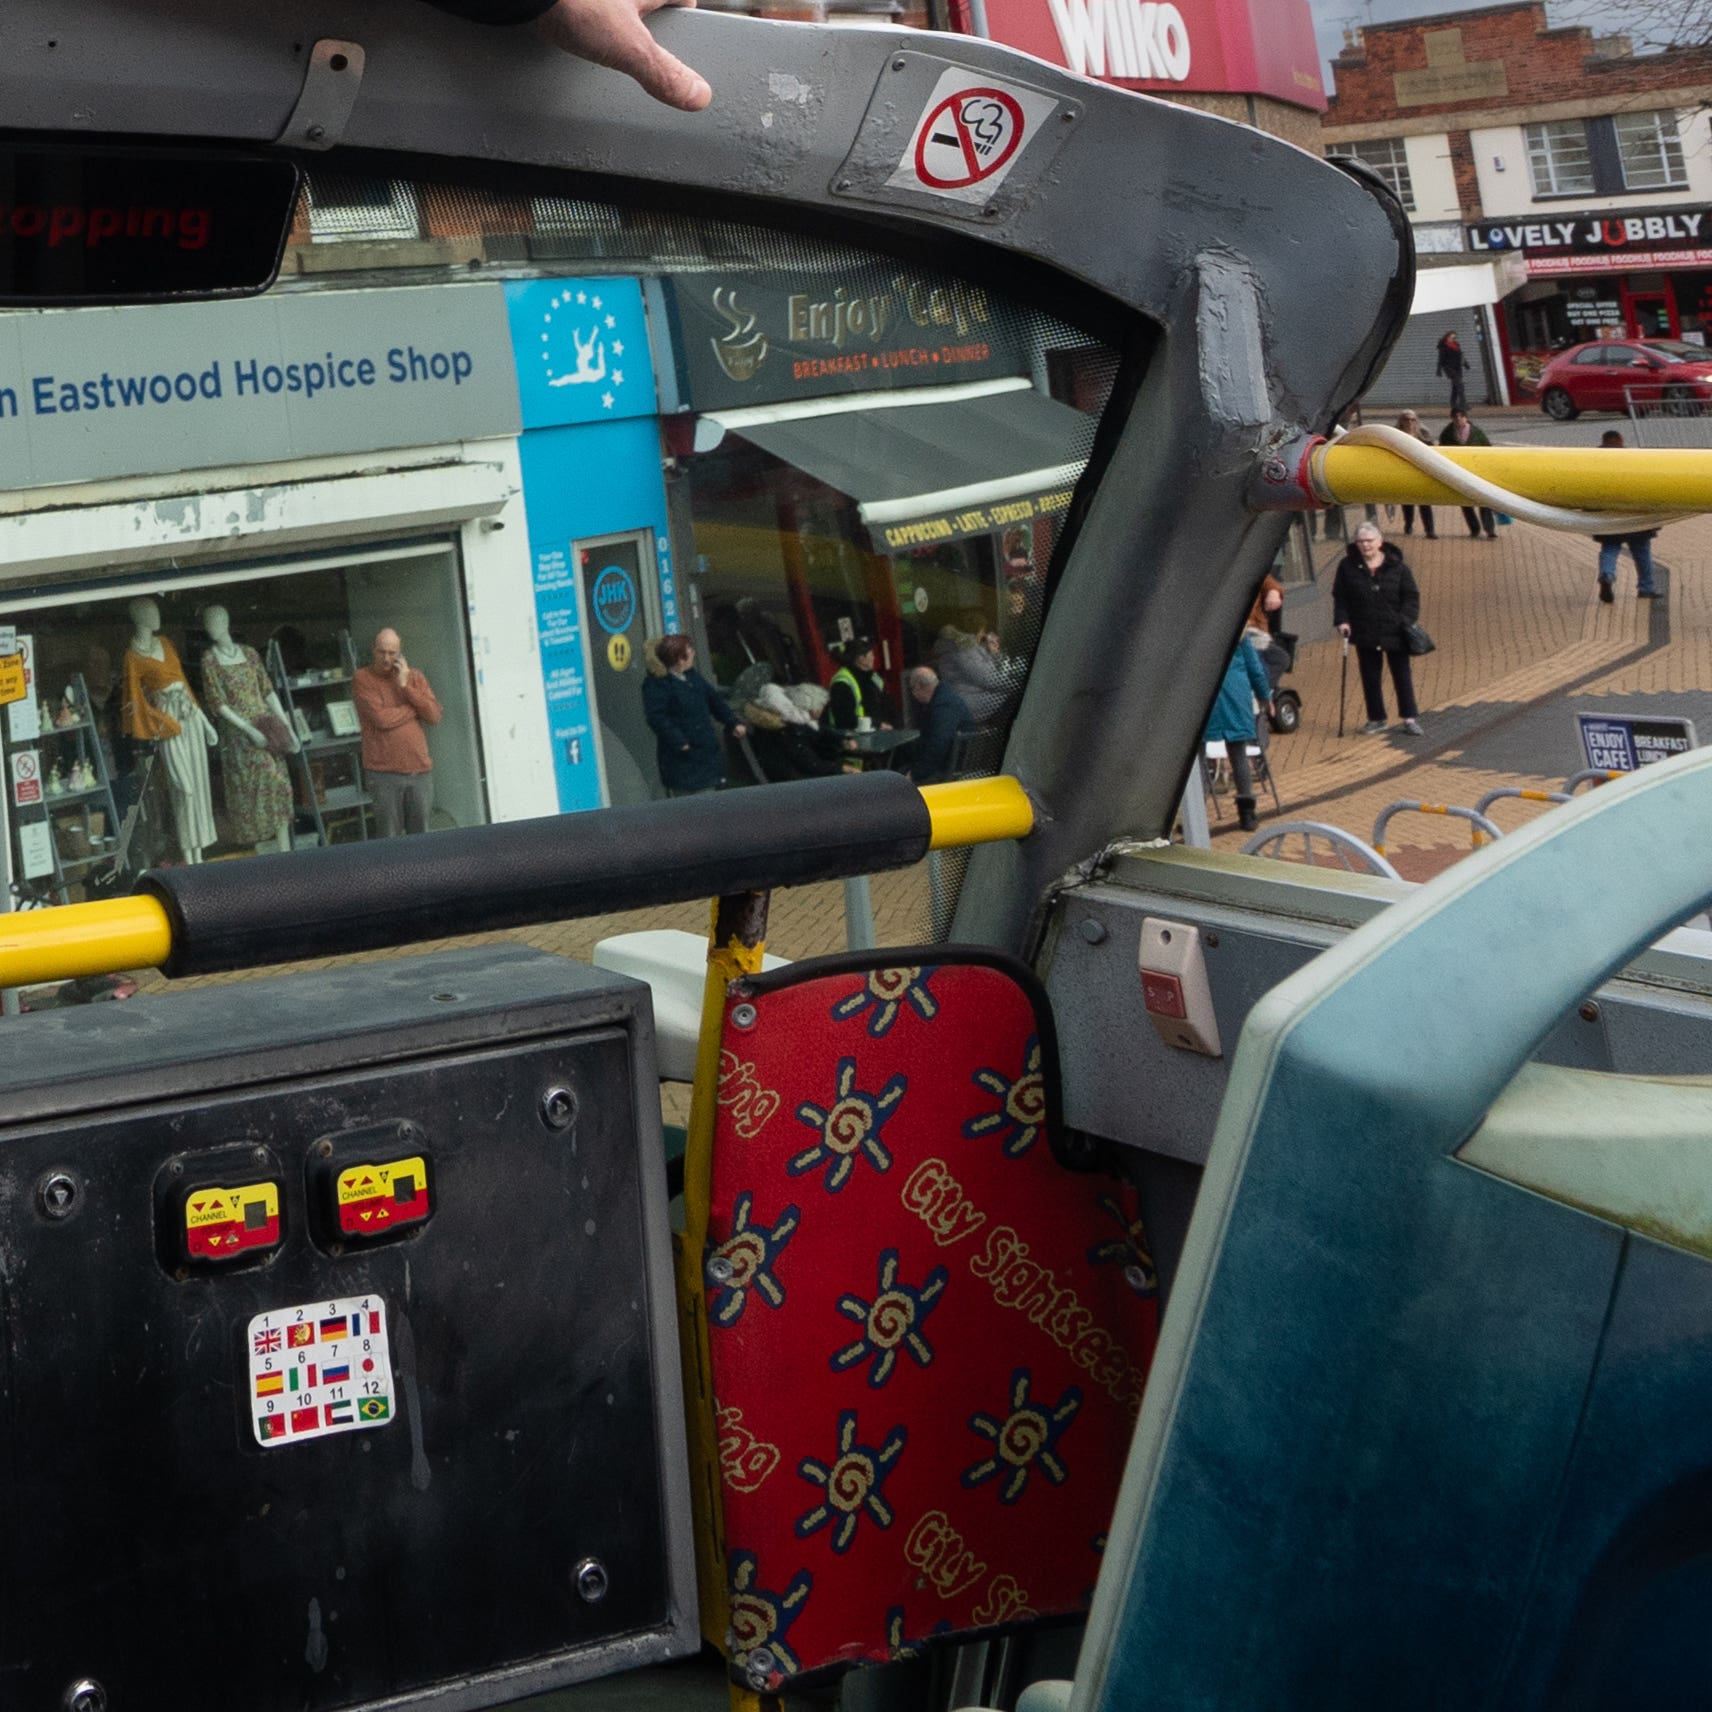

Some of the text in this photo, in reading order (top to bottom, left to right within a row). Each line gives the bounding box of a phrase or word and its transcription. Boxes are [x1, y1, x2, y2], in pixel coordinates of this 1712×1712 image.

[787, 287, 889, 349] Enjoy
[793, 343, 990, 380] BREAKFAST LUNCH DINNER
[32, 361, 222, 415] Eastwood
[234, 352, 376, 398] Hospice
[387, 346, 472, 386] Shop
[599, 580, 628, 605] JHK
[3, 659, 19, 670] Zone
[1588, 732, 1625, 749] ENJOY
[1633, 735, 1689, 751] BREAKFAST
[1592, 749, 1629, 769] CAFE
[342, 1186, 377, 1201] CHANNEL
[901, 1158, 986, 1247] City
[191, 1210, 228, 1224] CHANNEL
[263, 1299, 369, 1327] 1 2 3 4
[265, 1339, 371, 1370] 5 6 7 8
[266, 1381, 380, 1412] 9 10 11 12
[904, 1509, 988, 1599] City
